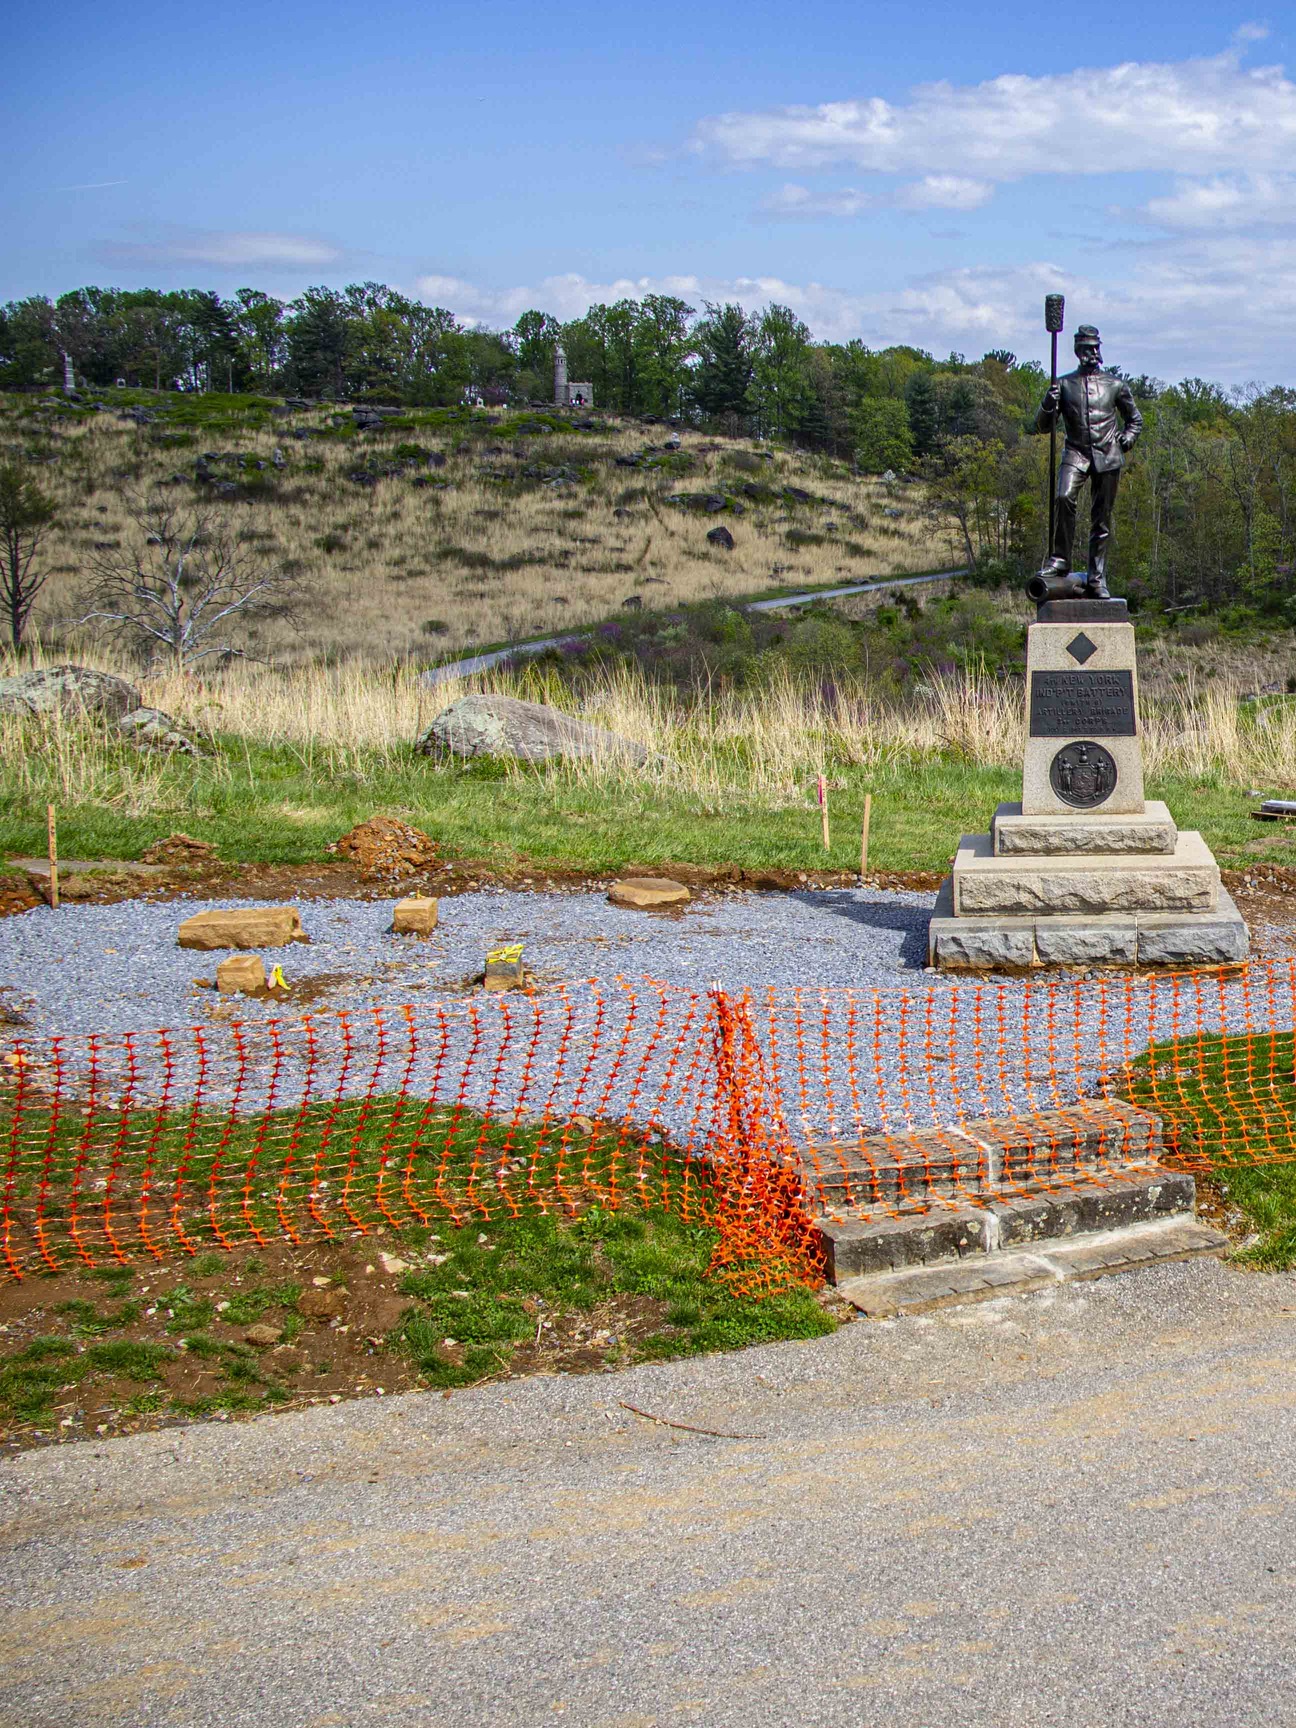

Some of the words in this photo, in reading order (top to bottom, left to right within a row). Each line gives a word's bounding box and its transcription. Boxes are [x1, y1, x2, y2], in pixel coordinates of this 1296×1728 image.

[1062, 675, 1084, 685] NEW
[1089, 674, 1120, 685] YORK
[1077, 686, 1127, 697] BATTERY
[1037, 707, 1082, 716] ARTILLERY
[1075, 717, 1108, 725] CORPS
